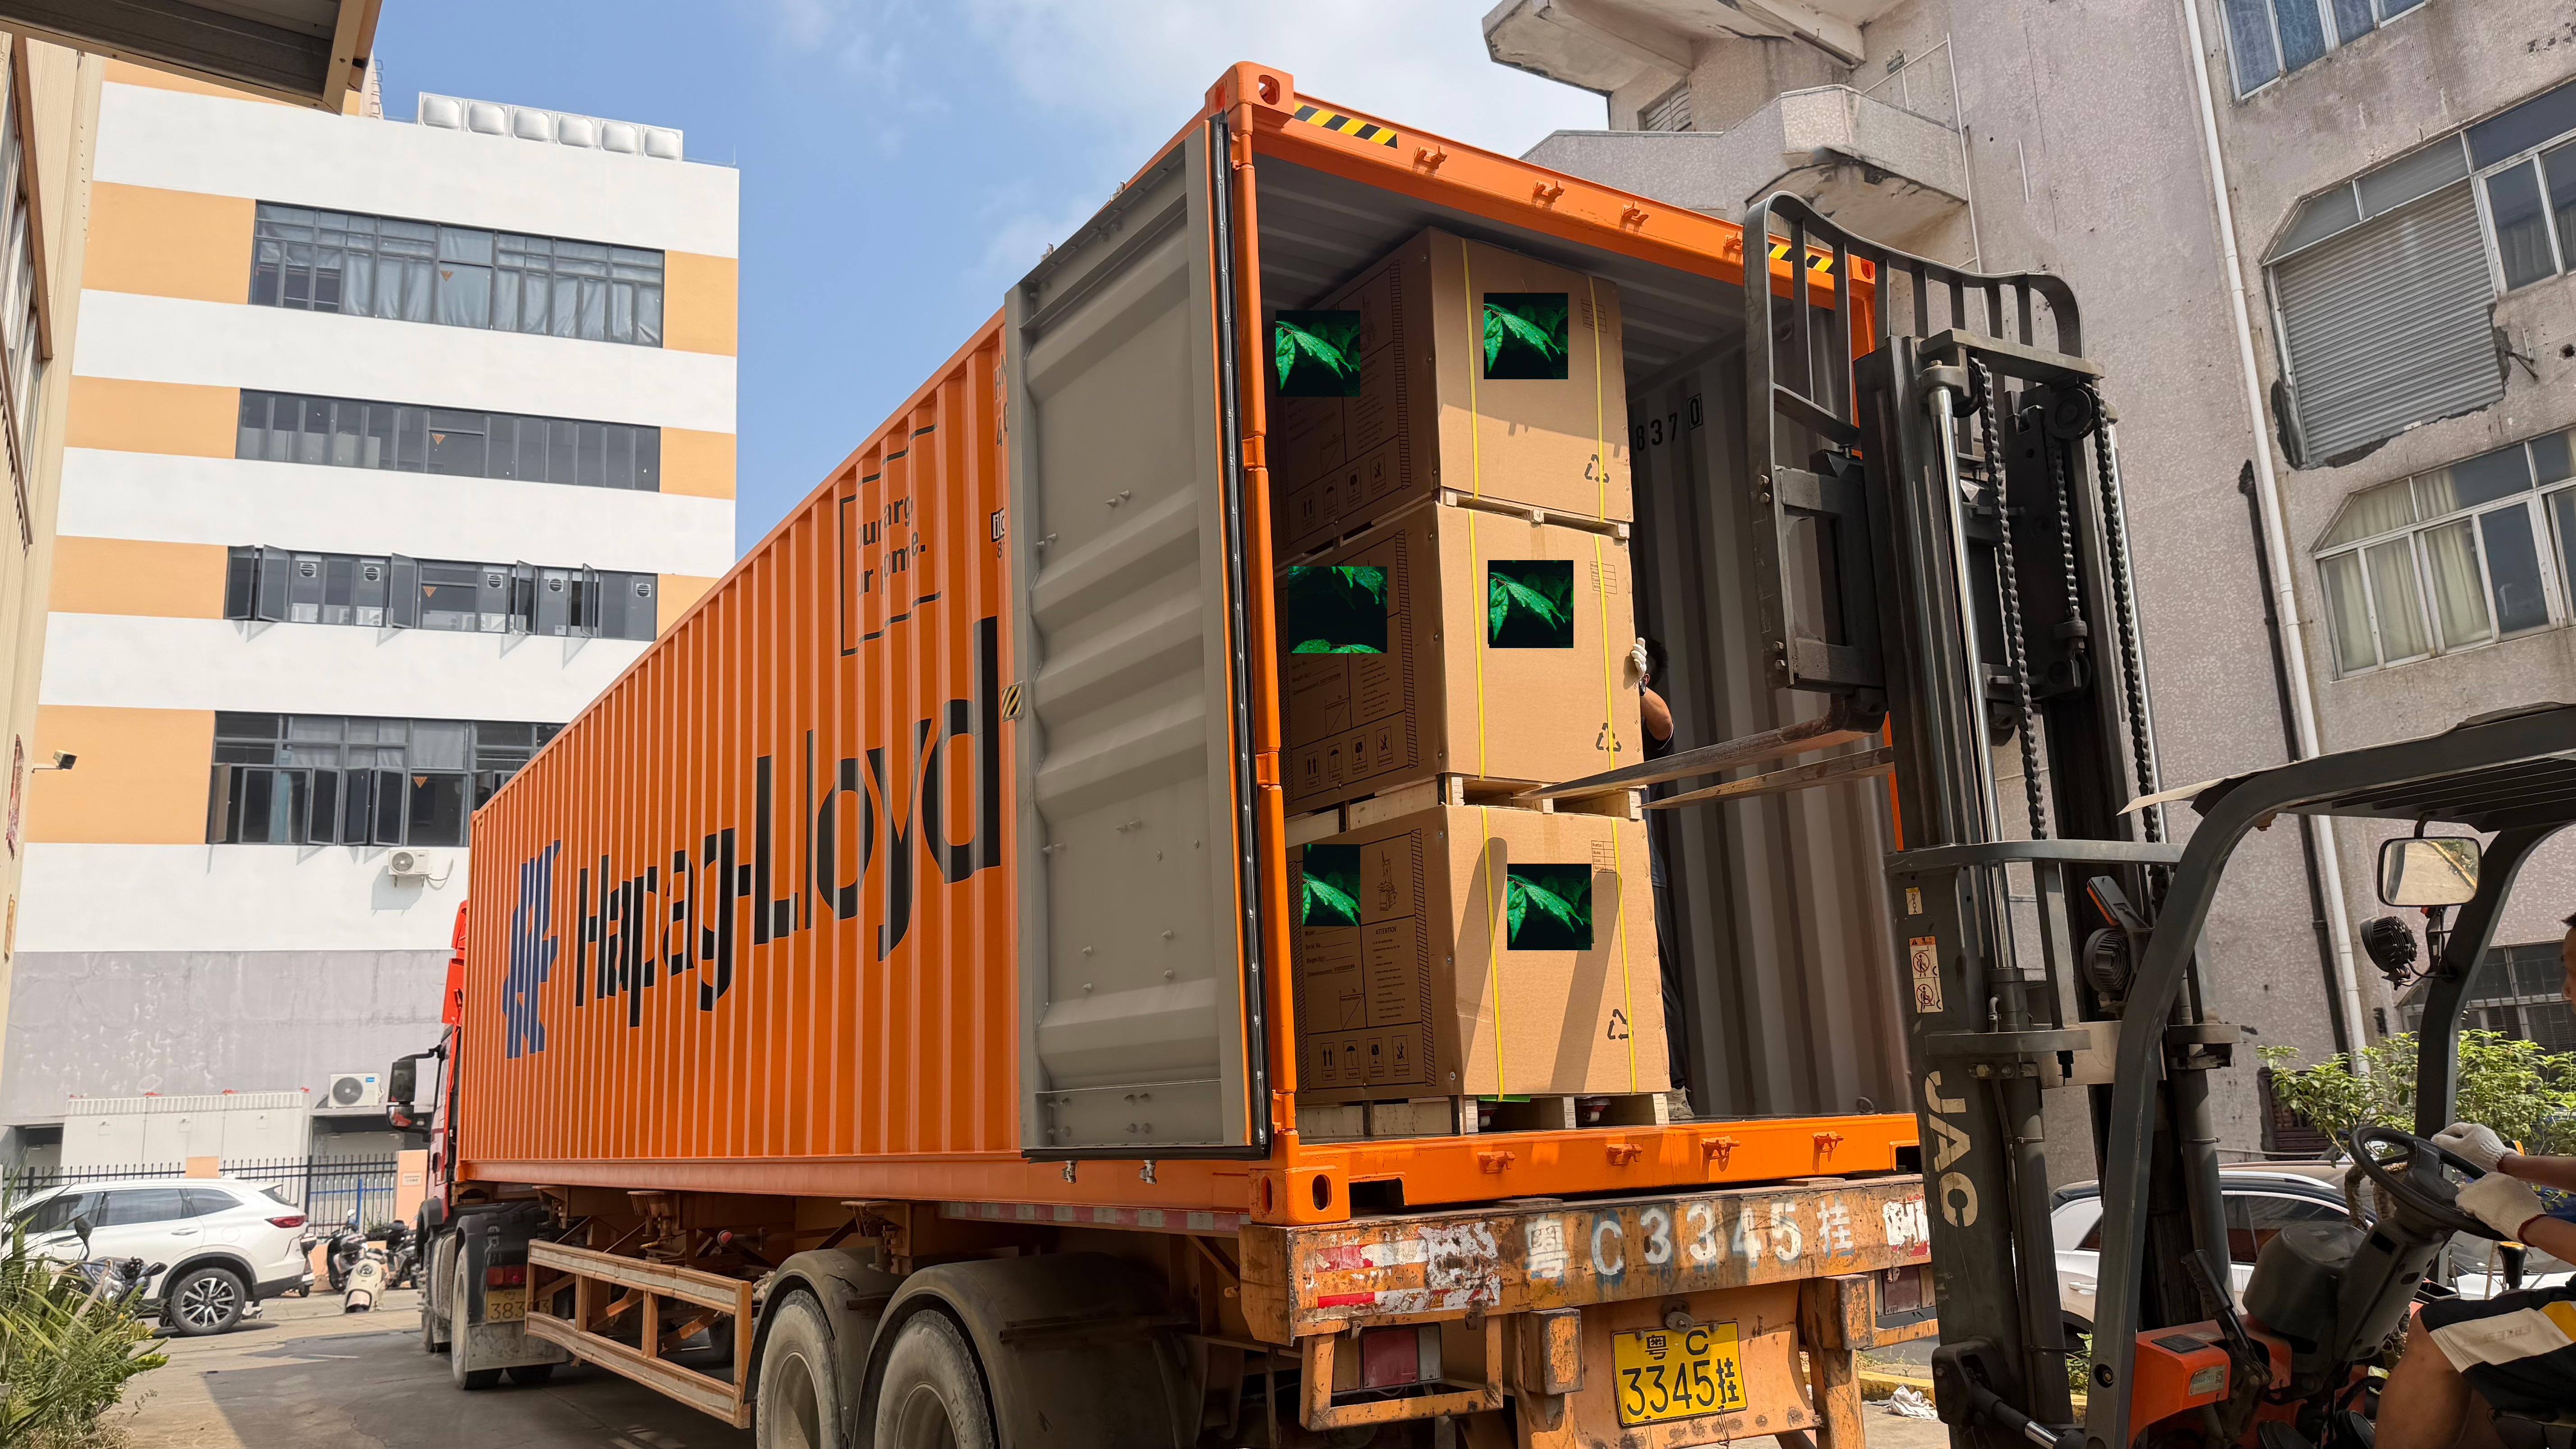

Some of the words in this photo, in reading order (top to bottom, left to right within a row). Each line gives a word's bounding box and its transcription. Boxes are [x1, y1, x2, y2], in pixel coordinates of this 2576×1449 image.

[575, 616, 1001, 1027] Hapag-Lloyd
[1924, 1070, 1979, 1228] JAC
[491, 1299, 549, 1320] 3833
[1622, 1357, 1740, 1416] 3345挂
